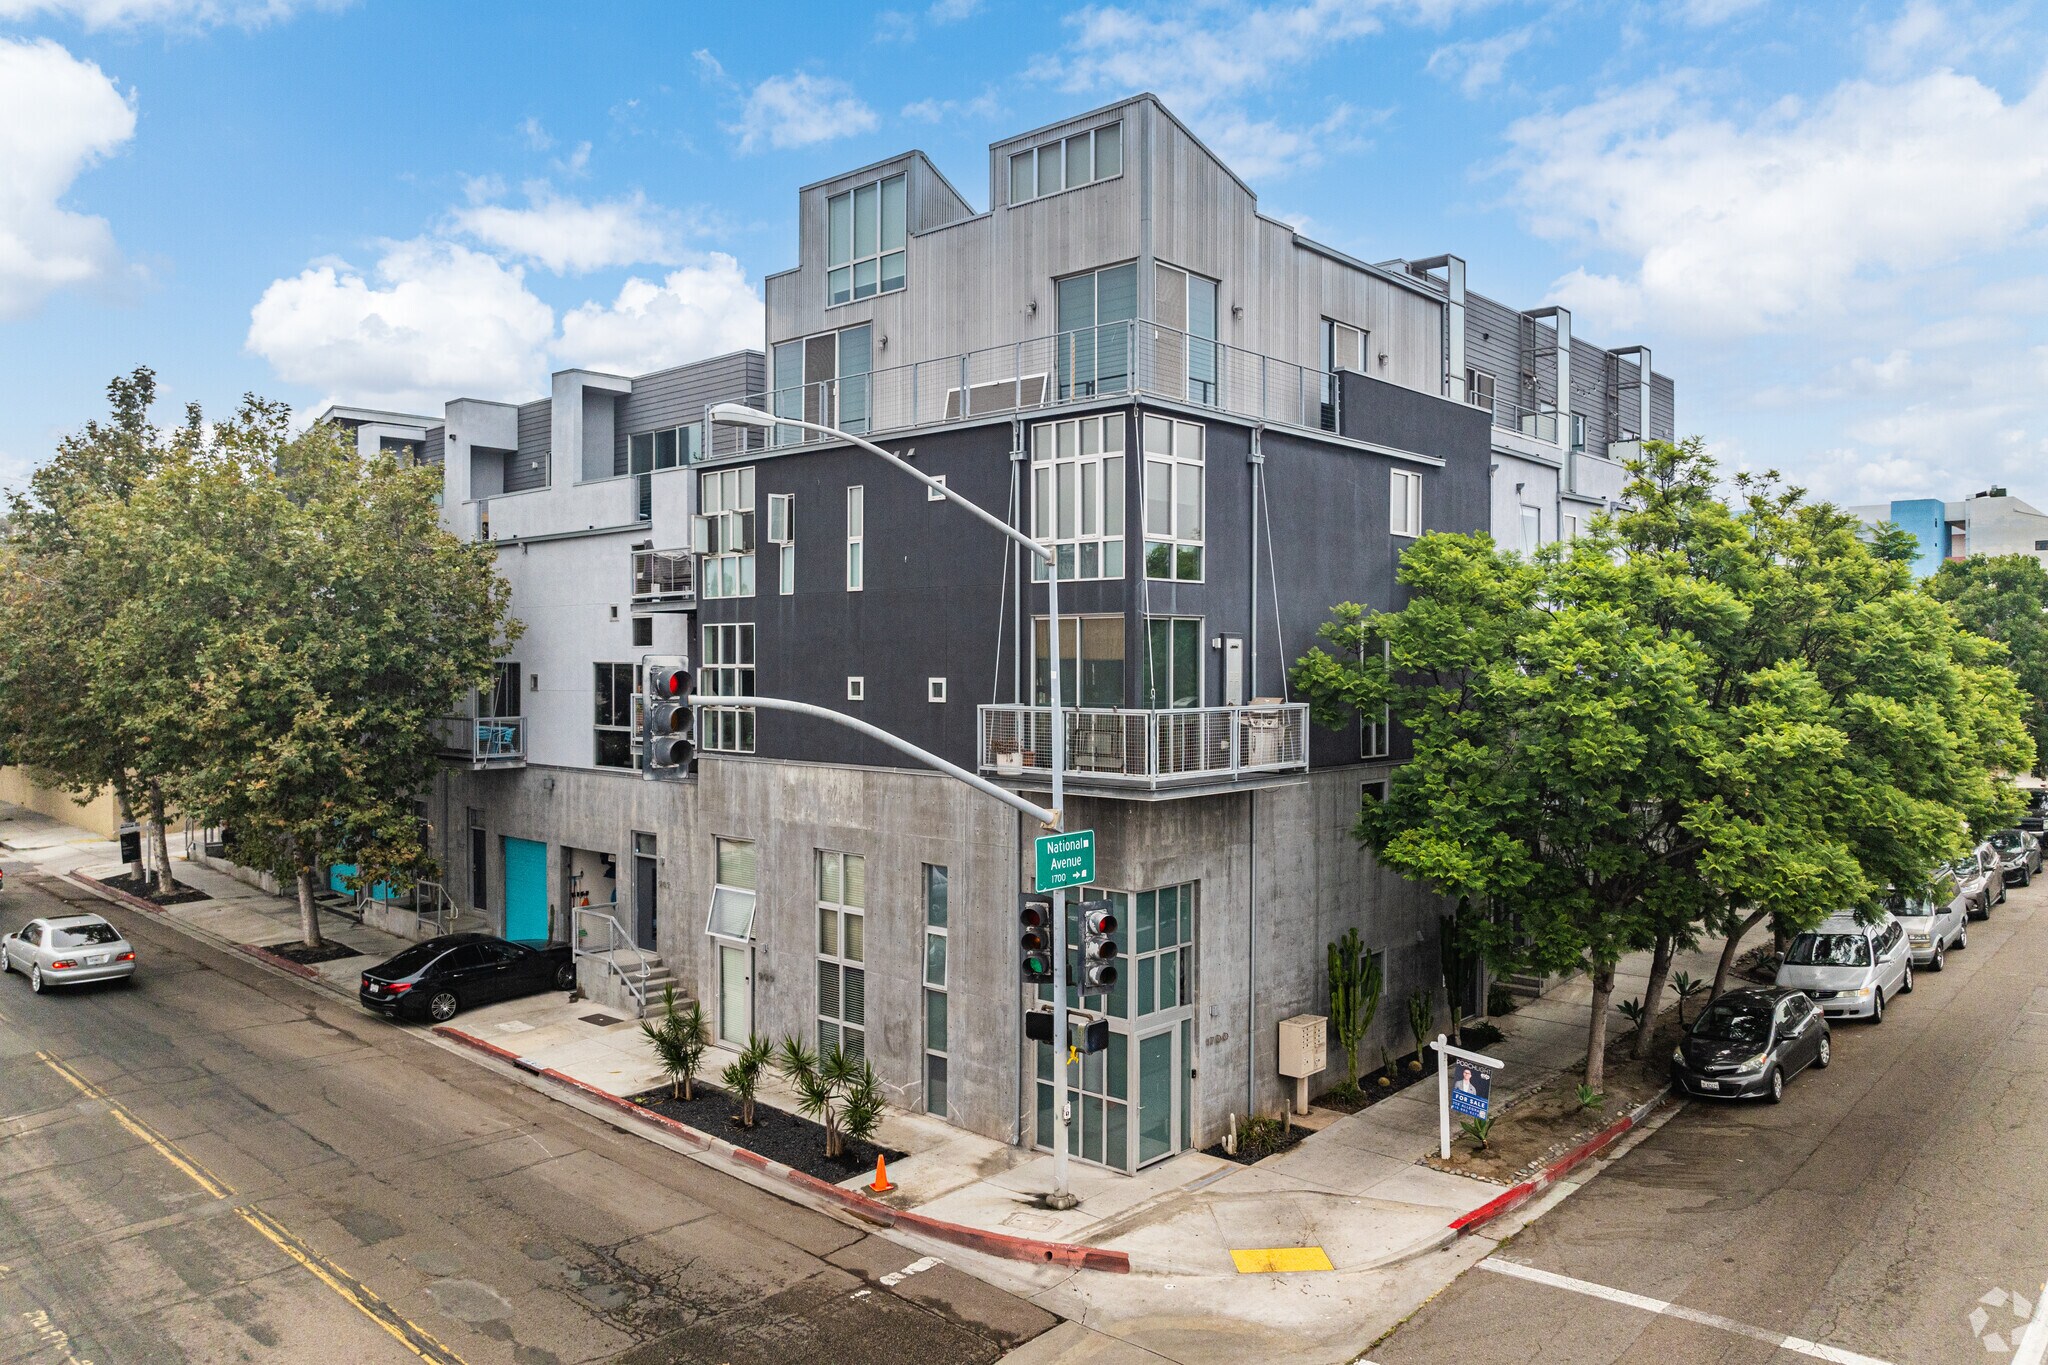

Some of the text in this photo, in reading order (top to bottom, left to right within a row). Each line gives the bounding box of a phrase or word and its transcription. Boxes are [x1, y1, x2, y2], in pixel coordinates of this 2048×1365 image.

[1047, 837, 1083, 854] National
[1050, 856, 1082, 870] Avenue
[1051, 873, 1066, 883] 1700
[1456, 1059, 1491, 1074] PORCHLIGHT
[1455, 1094, 1486, 1108] FOR SALE
